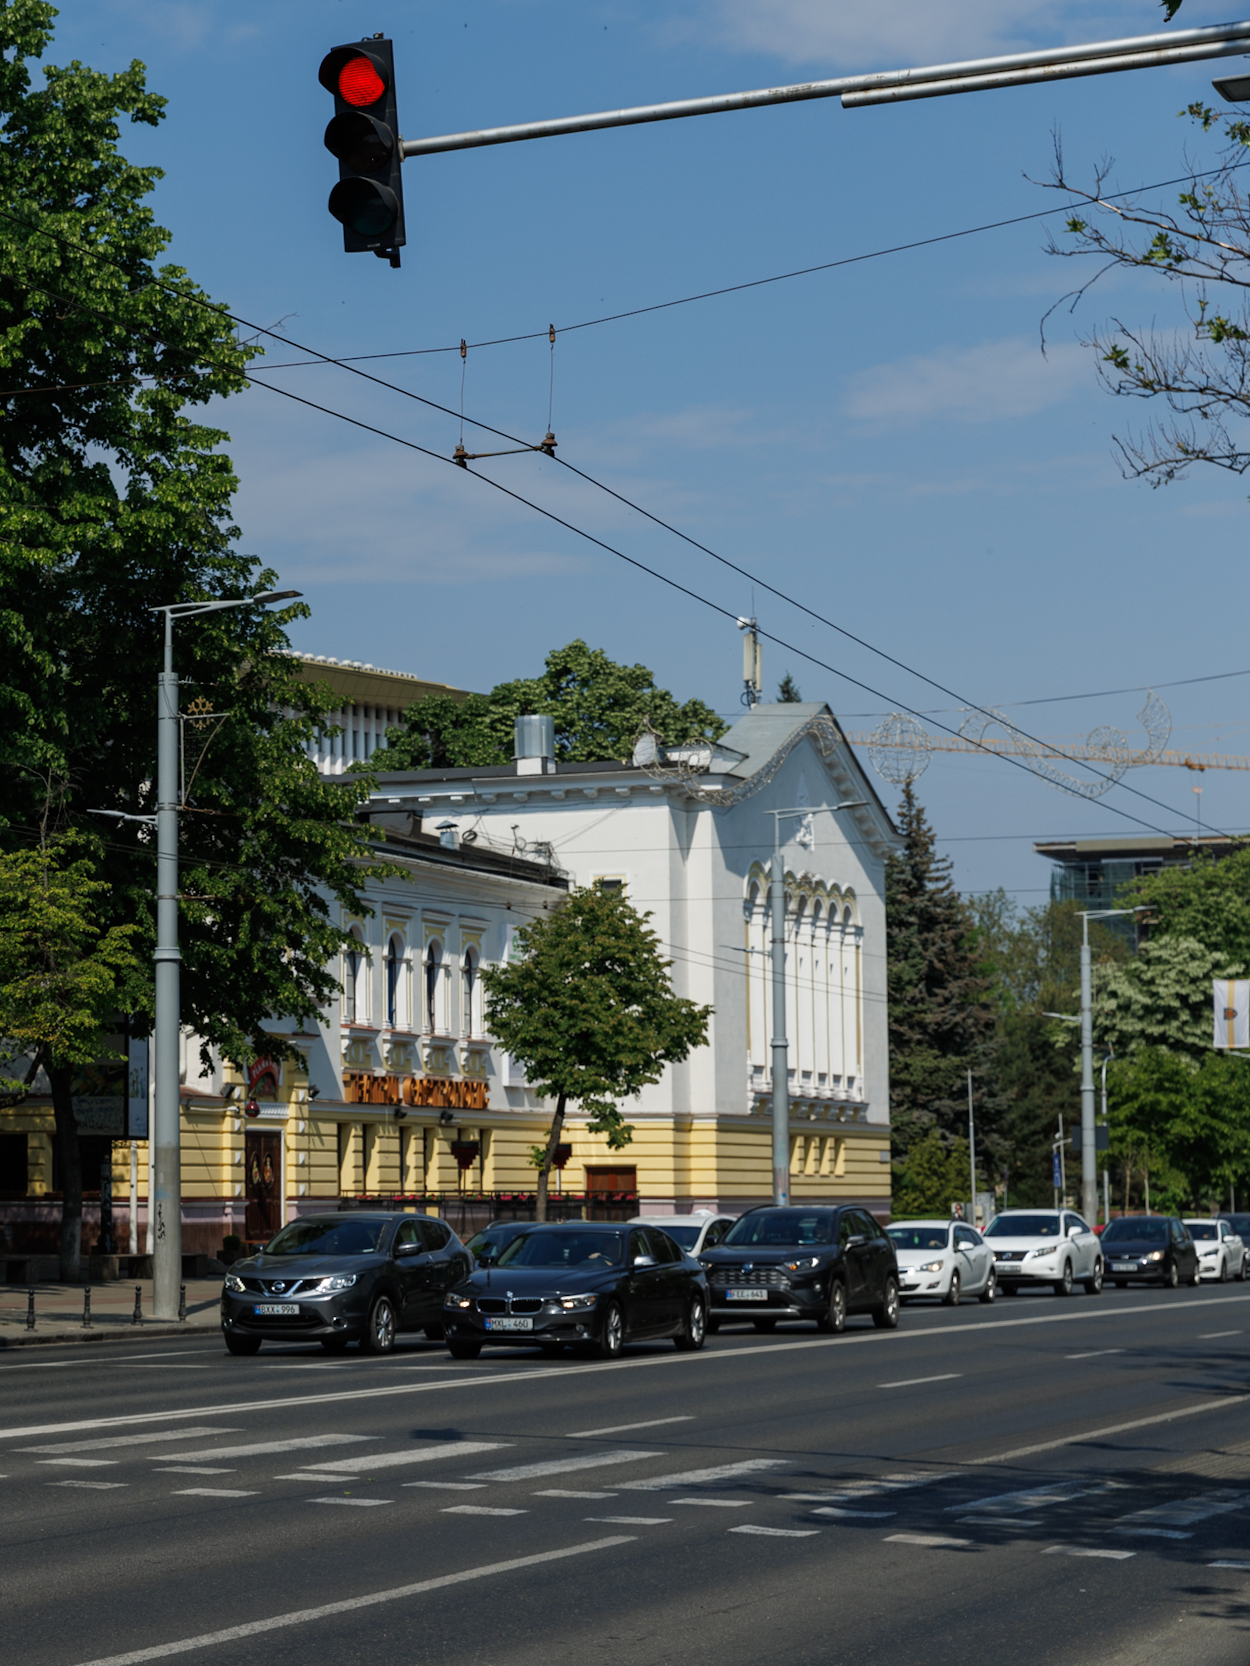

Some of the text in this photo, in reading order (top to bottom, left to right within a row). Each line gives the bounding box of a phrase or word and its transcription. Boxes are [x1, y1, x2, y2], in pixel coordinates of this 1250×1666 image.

[261, 1305, 296, 1314] BXX 996
[513, 1319, 529, 1328] 460
